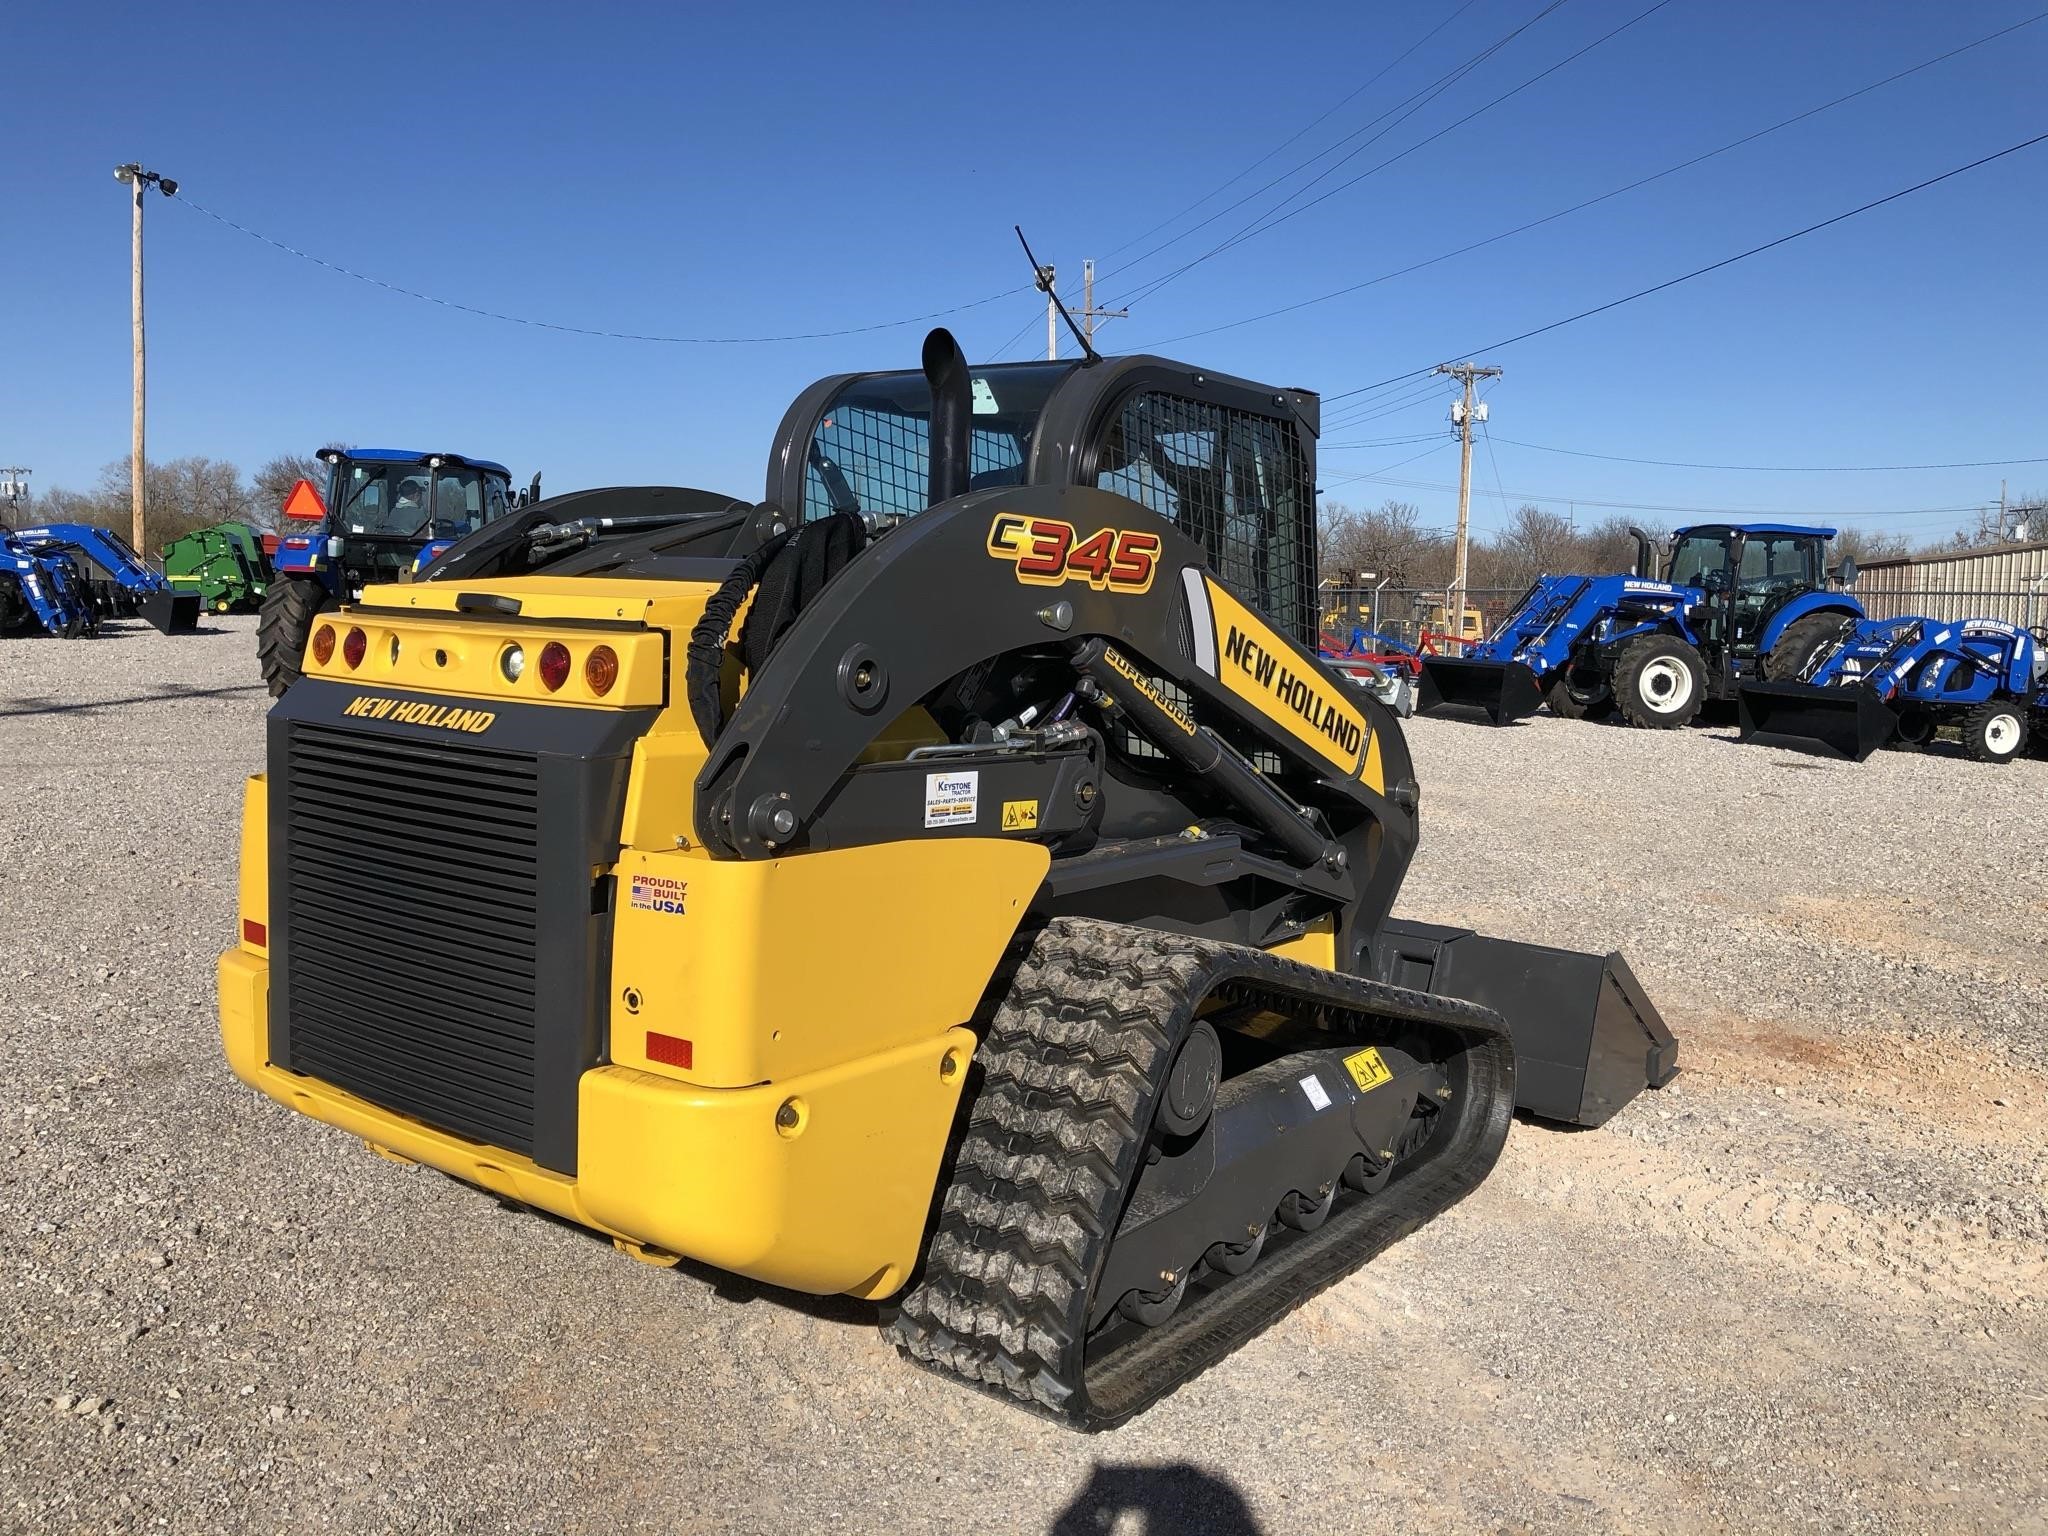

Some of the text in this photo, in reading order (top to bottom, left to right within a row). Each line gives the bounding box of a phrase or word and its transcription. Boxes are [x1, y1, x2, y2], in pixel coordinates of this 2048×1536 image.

[987, 513, 1161, 594] C345
[1624, 580, 1673, 592] NEW HOLLAND
[1964, 620, 2015, 634] NEW HOLLAND
[1104, 646, 1197, 737] SUPER BOOM
[1224, 625, 1361, 757] NEW HOLLAND
[343, 696, 496, 734] NEW HOLLAND
[938, 781, 971, 791] KEYSTONE
[632, 875, 688, 891] PROUDLY
[653, 888, 688, 901] BUILT
[631, 899, 686, 915] in the USA
